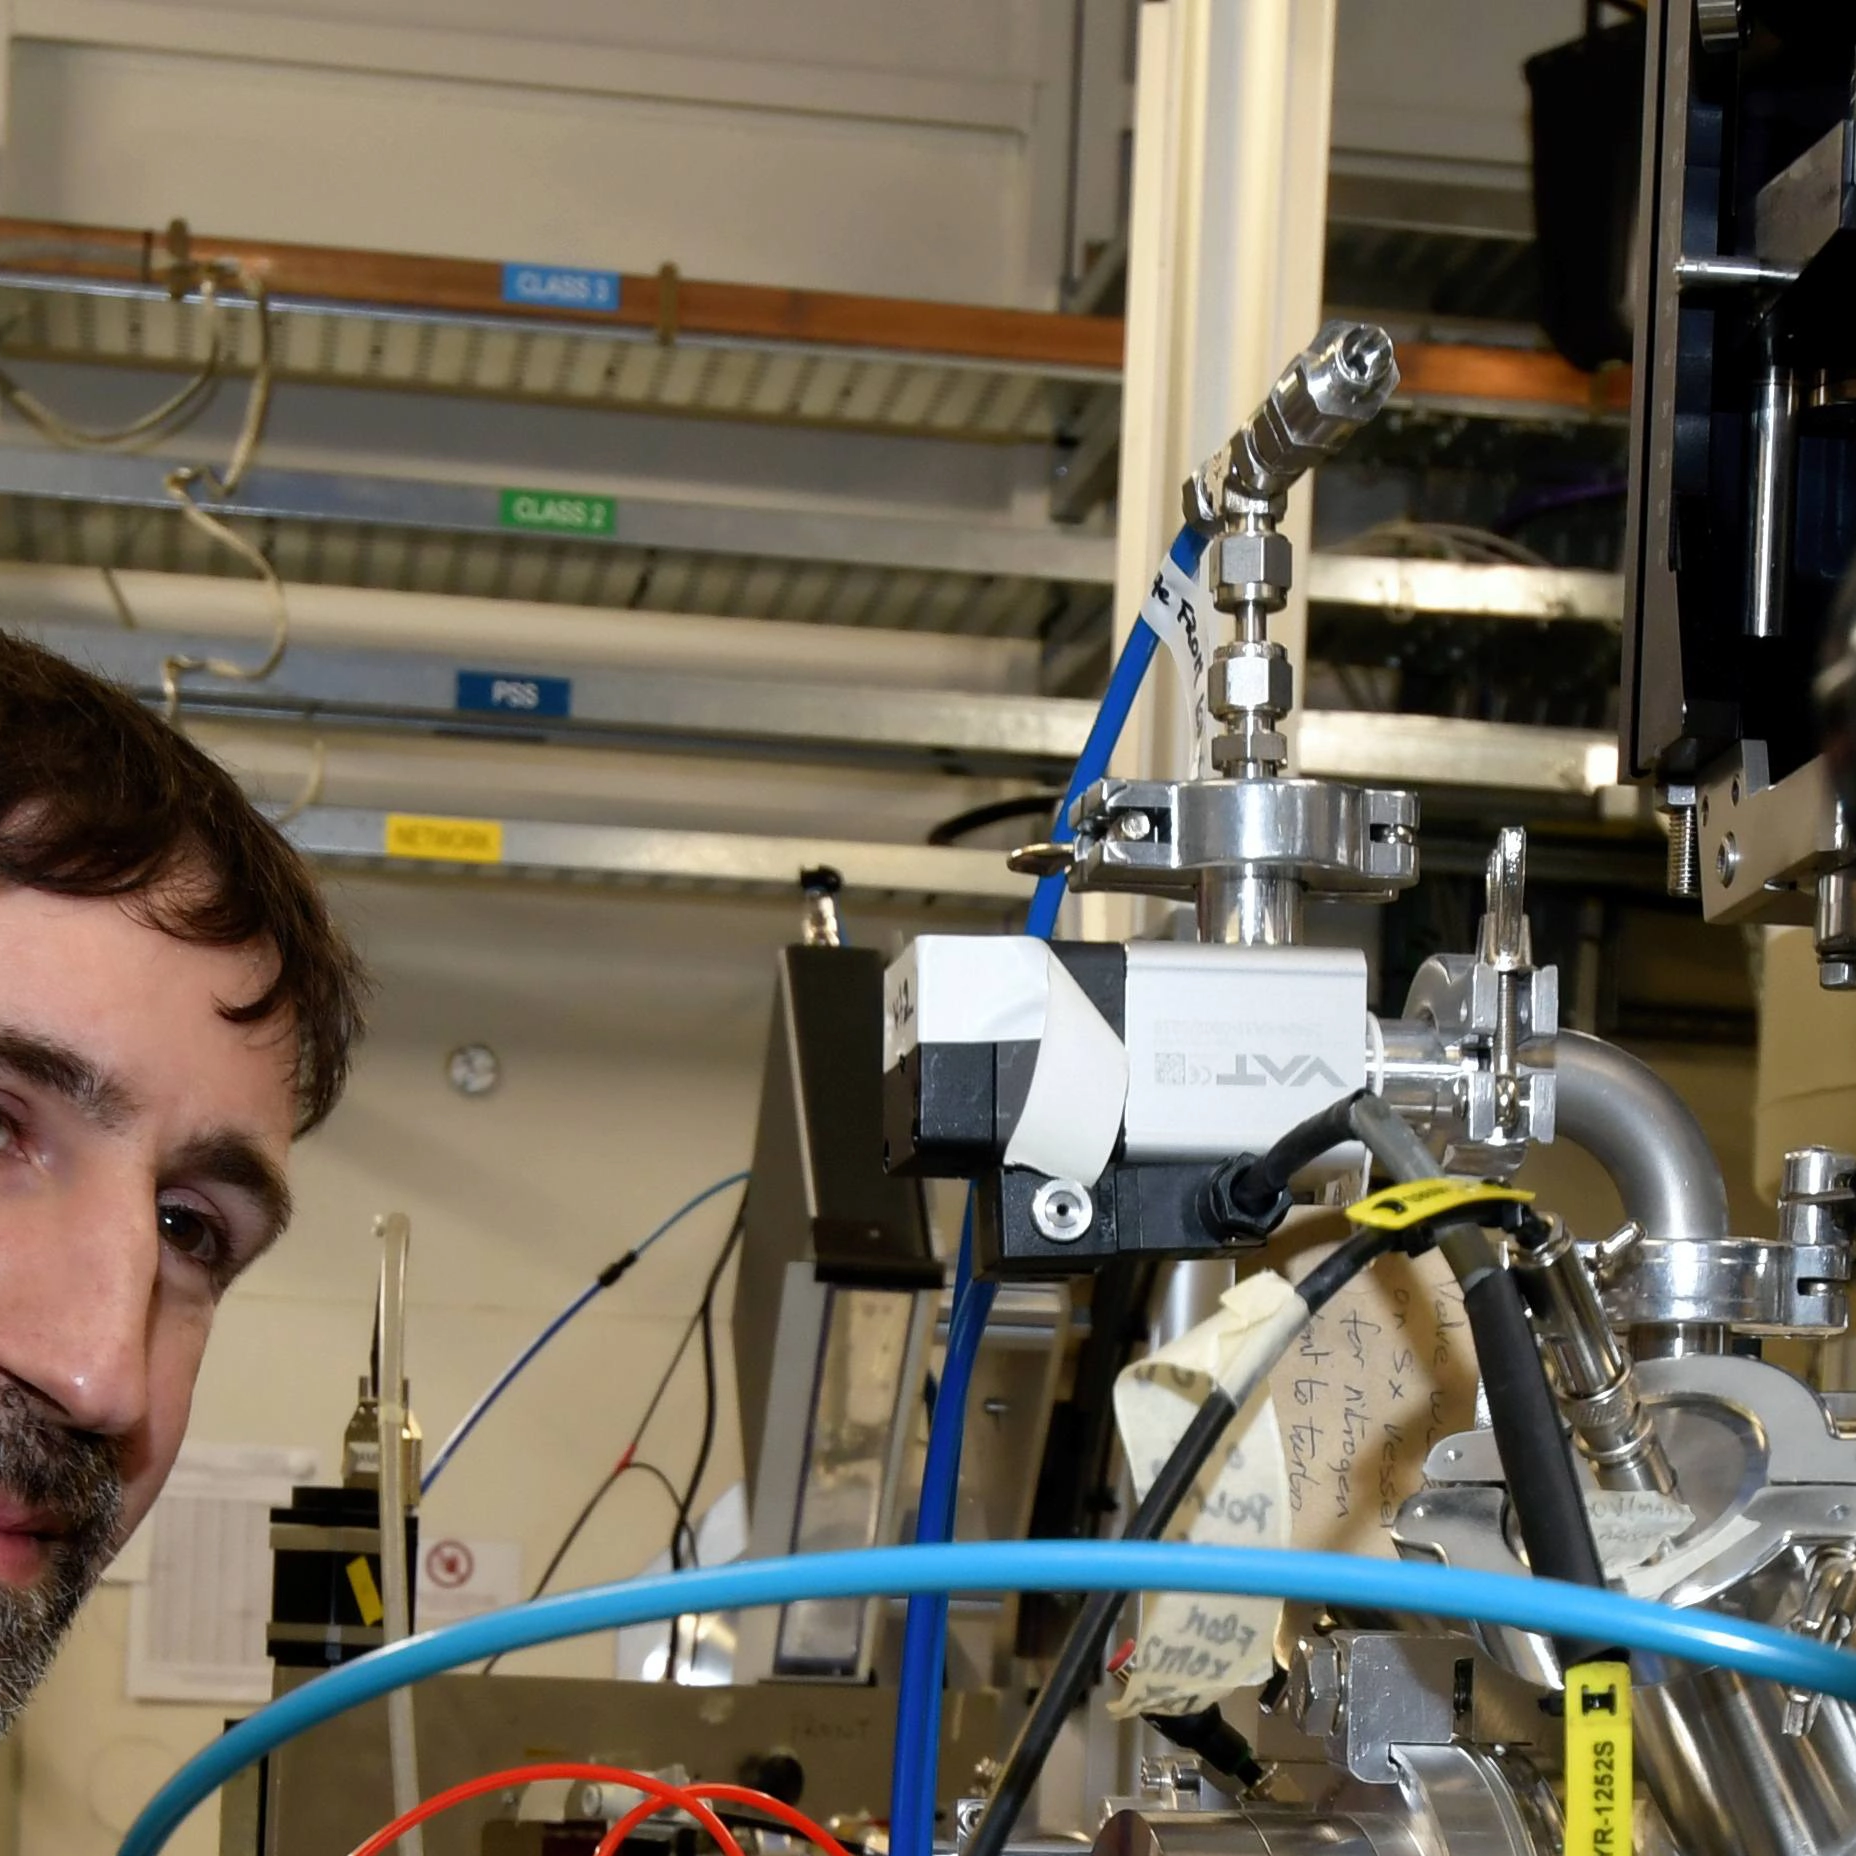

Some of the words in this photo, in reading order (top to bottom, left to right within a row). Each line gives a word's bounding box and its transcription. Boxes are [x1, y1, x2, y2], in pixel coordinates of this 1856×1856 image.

[516, 269, 591, 302] CLASS
[512, 496, 589, 530] CLASS
[490, 679, 539, 709] PSS
[394, 822, 493, 853] NETWORK
[1216, 1053, 1348, 1087] VAT
[1391, 1289, 1411, 1330] on
[1339, 1309, 1382, 1369] for
[1293, 1378, 1330, 1406] to
[1288, 1415, 1325, 1513] turbo
[1327, 1384, 1373, 1518] nitrogen
